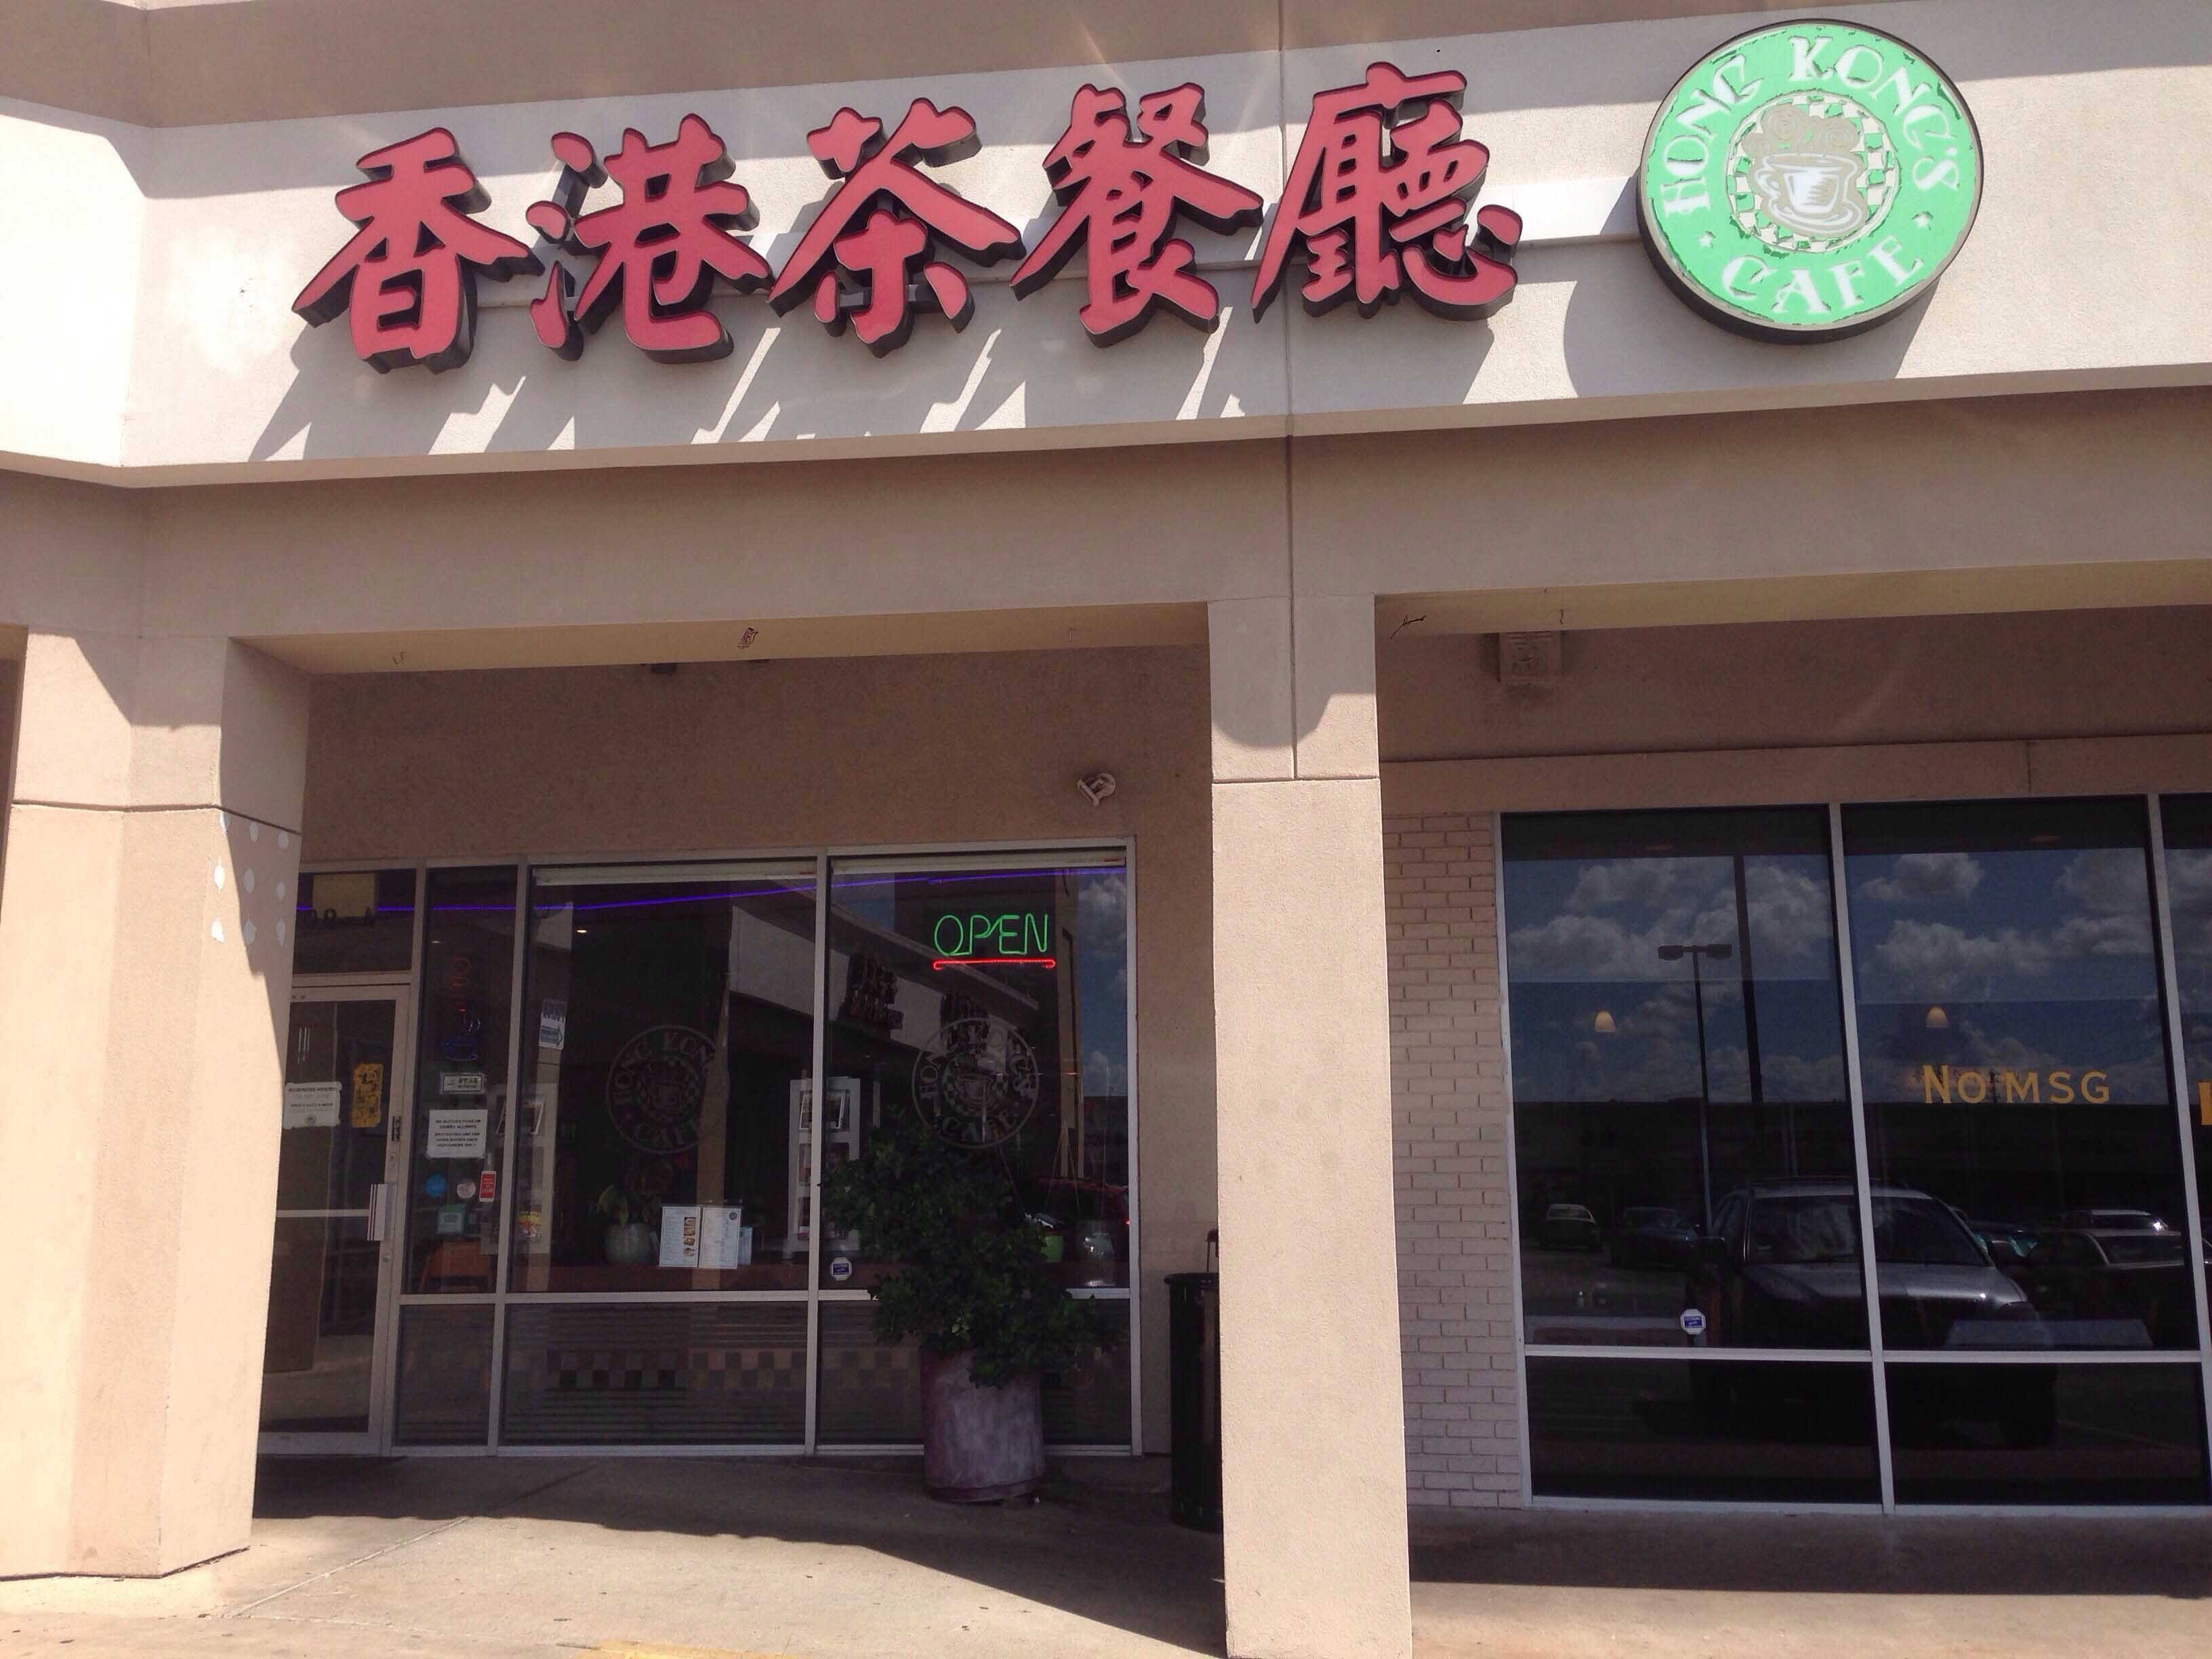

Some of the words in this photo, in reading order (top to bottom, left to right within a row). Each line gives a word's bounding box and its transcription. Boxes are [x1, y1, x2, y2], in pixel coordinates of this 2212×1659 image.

[1660, 54, 1764, 218] HONG
[1788, 36, 1960, 192] KONG'S
[293, 62, 1522, 366] 香港茶餐廳
[1722, 236, 1924, 314] CAFE
[934, 914, 1049, 957] OPEN
[1923, 1065, 1986, 1105] NO
[2005, 1071, 2110, 1105] MSG
